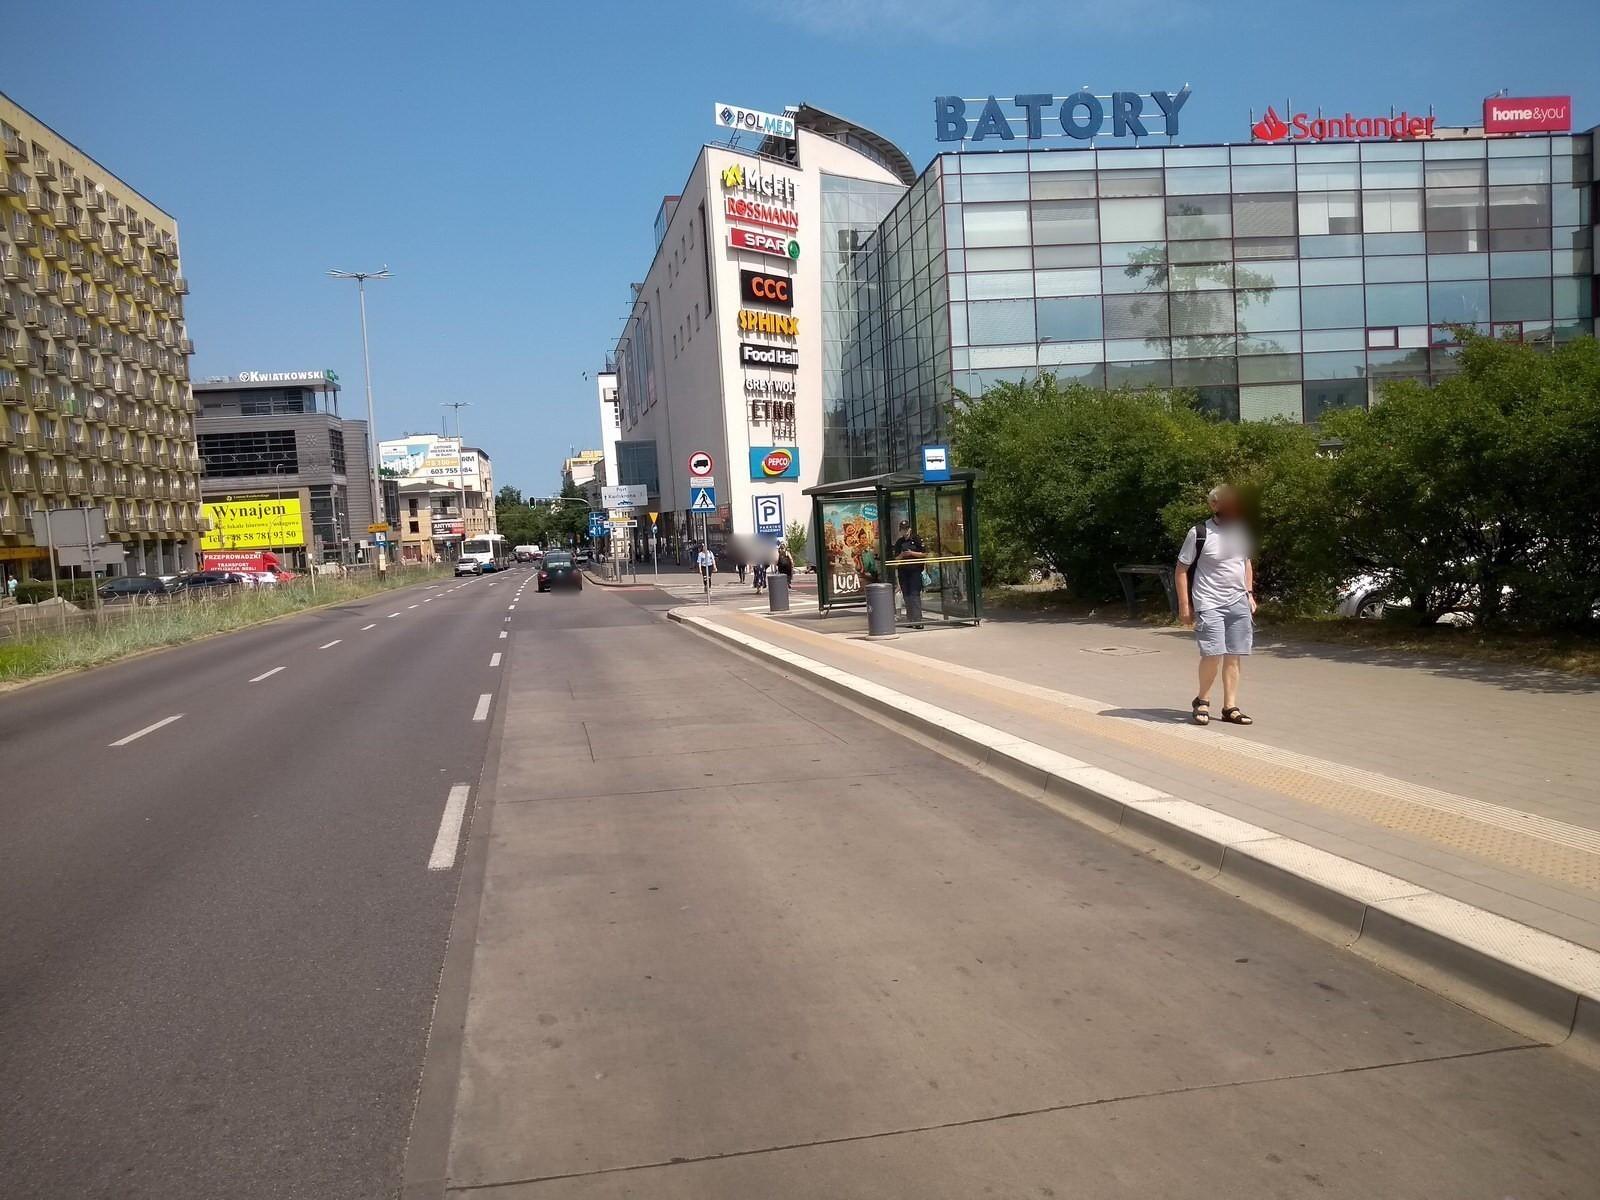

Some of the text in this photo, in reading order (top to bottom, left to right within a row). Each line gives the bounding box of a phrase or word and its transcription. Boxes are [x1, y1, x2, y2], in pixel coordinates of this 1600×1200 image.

[736, 110, 793, 135] POLMED
[935, 91, 1192, 141] BATORY
[1492, 106, 1564, 123] home&you
[1292, 112, 1436, 140] Santander
[727, 197, 798, 227] ROSSMANN
[744, 233, 786, 251] SPAR
[751, 277, 788, 301] CCC
[739, 310, 799, 335] SPHINX
[743, 347, 798, 365] Food Hall
[745, 379, 770, 391] GREY
[752, 400, 795, 421] ETNO
[768, 457, 788, 467] PEPCO
[213, 504, 286, 520] Wynajem
[286, 530, 296, 538] 50
[833, 573, 860, 593] LUCA
